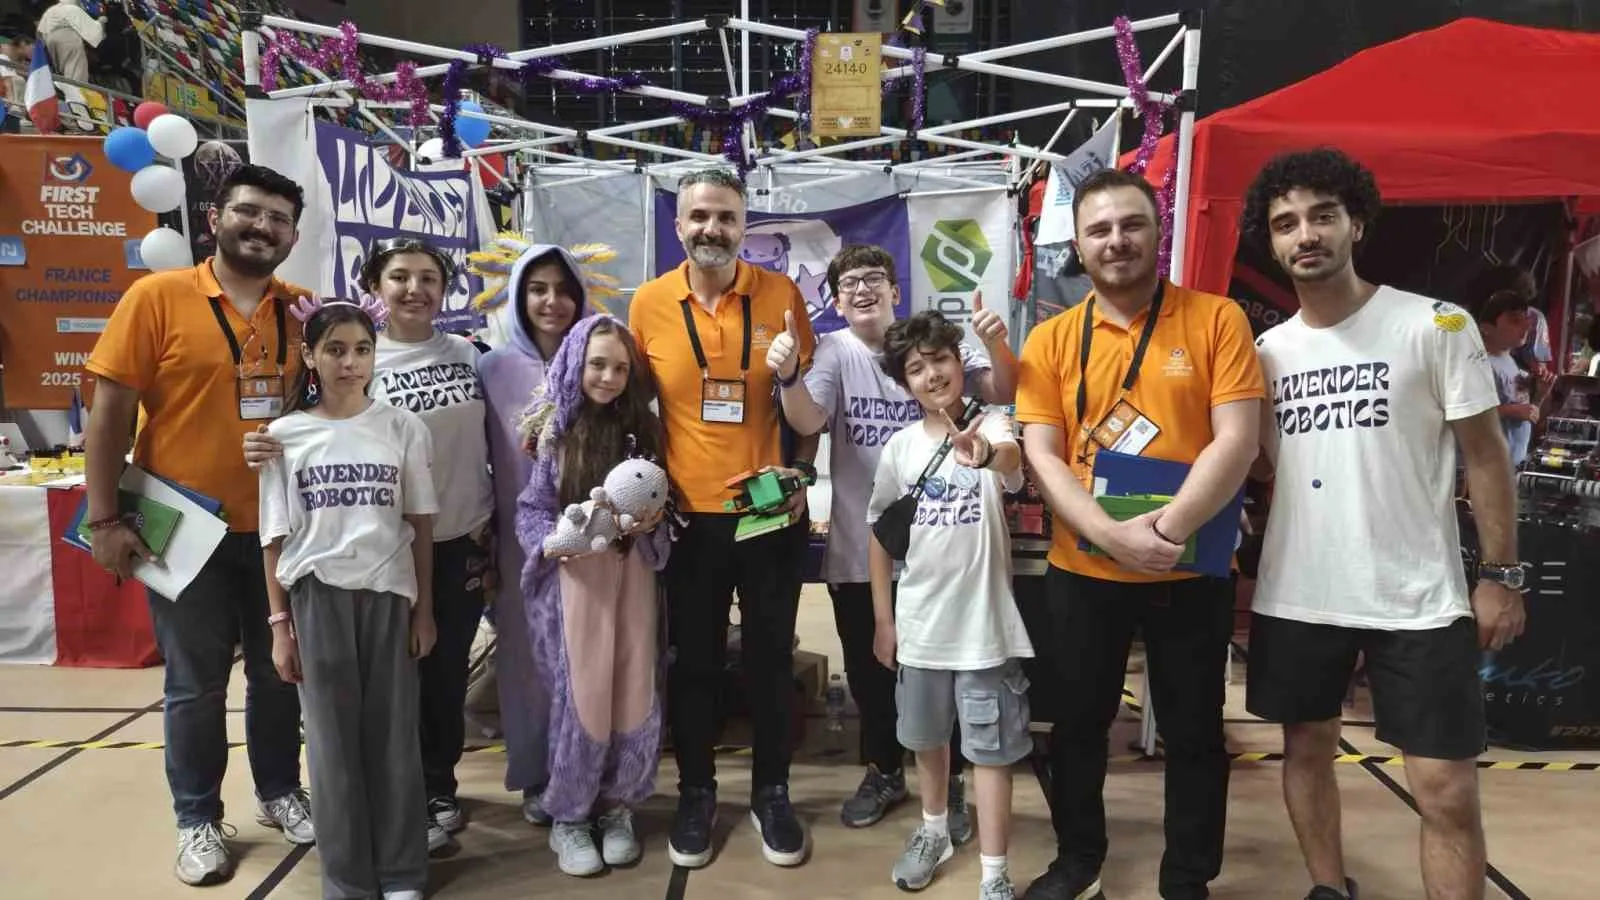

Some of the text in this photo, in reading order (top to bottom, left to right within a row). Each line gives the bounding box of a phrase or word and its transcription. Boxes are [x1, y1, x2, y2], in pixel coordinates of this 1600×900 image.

[825, 63, 867, 75] 24140
[40, 185, 100, 203] FIRST
[44, 204, 94, 220] TECH
[21, 220, 127, 237] CHALLENGE
[45, 269, 111, 283] FRANCE
[16, 288, 122, 303] CHAMPIONS
[54, 352, 92, 366] WIN
[41, 373, 82, 386] 2025
[382, 362, 478, 394] LAVENDER
[1273, 361, 1389, 405] LAVENDER
[295, 463, 399, 489] LAVENDER
